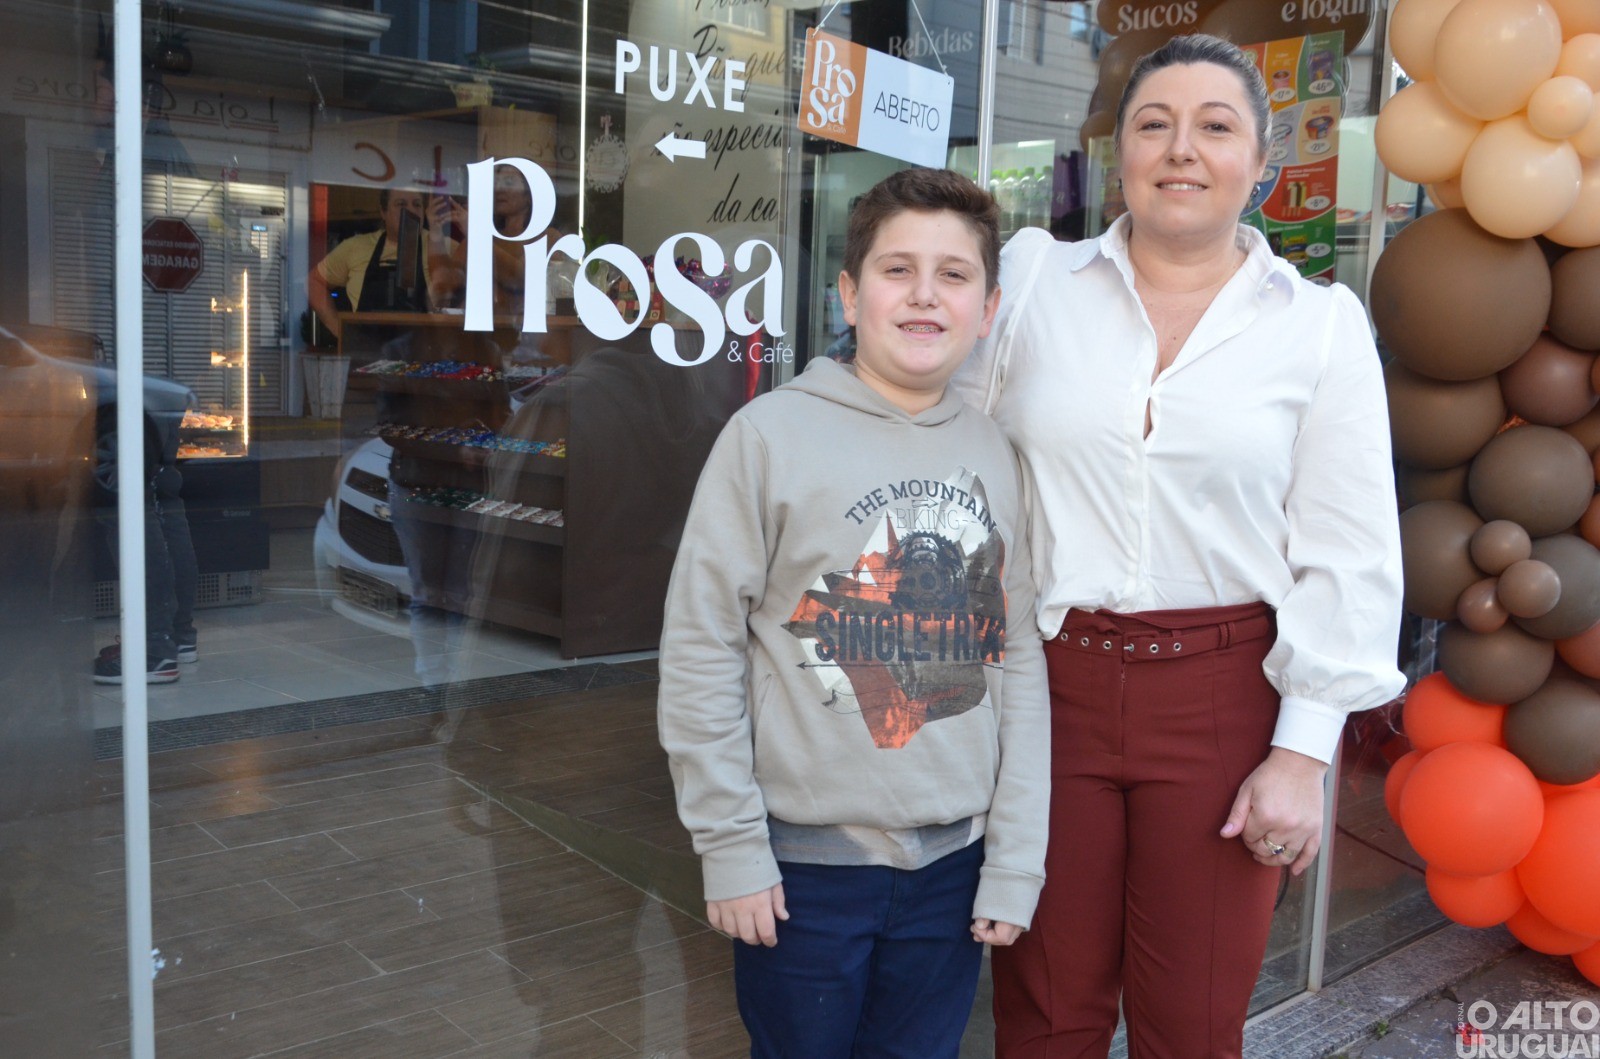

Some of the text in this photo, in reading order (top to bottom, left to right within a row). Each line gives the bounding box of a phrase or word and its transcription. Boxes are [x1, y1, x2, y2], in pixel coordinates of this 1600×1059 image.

[1117, 2, 1198, 33] Sucos
[1281, 1, 1296, 23] e
[888, 27, 974, 59] Bebidas
[615, 38, 746, 113] PUXE
[873, 90, 940, 132] ABERTO
[706, 172, 742, 223] da
[464, 156, 788, 367] Prosa
[727, 340, 794, 364] & Café
[844, 479, 997, 534] THE MOUNTAIN
[896, 507, 960, 531] BIKING
